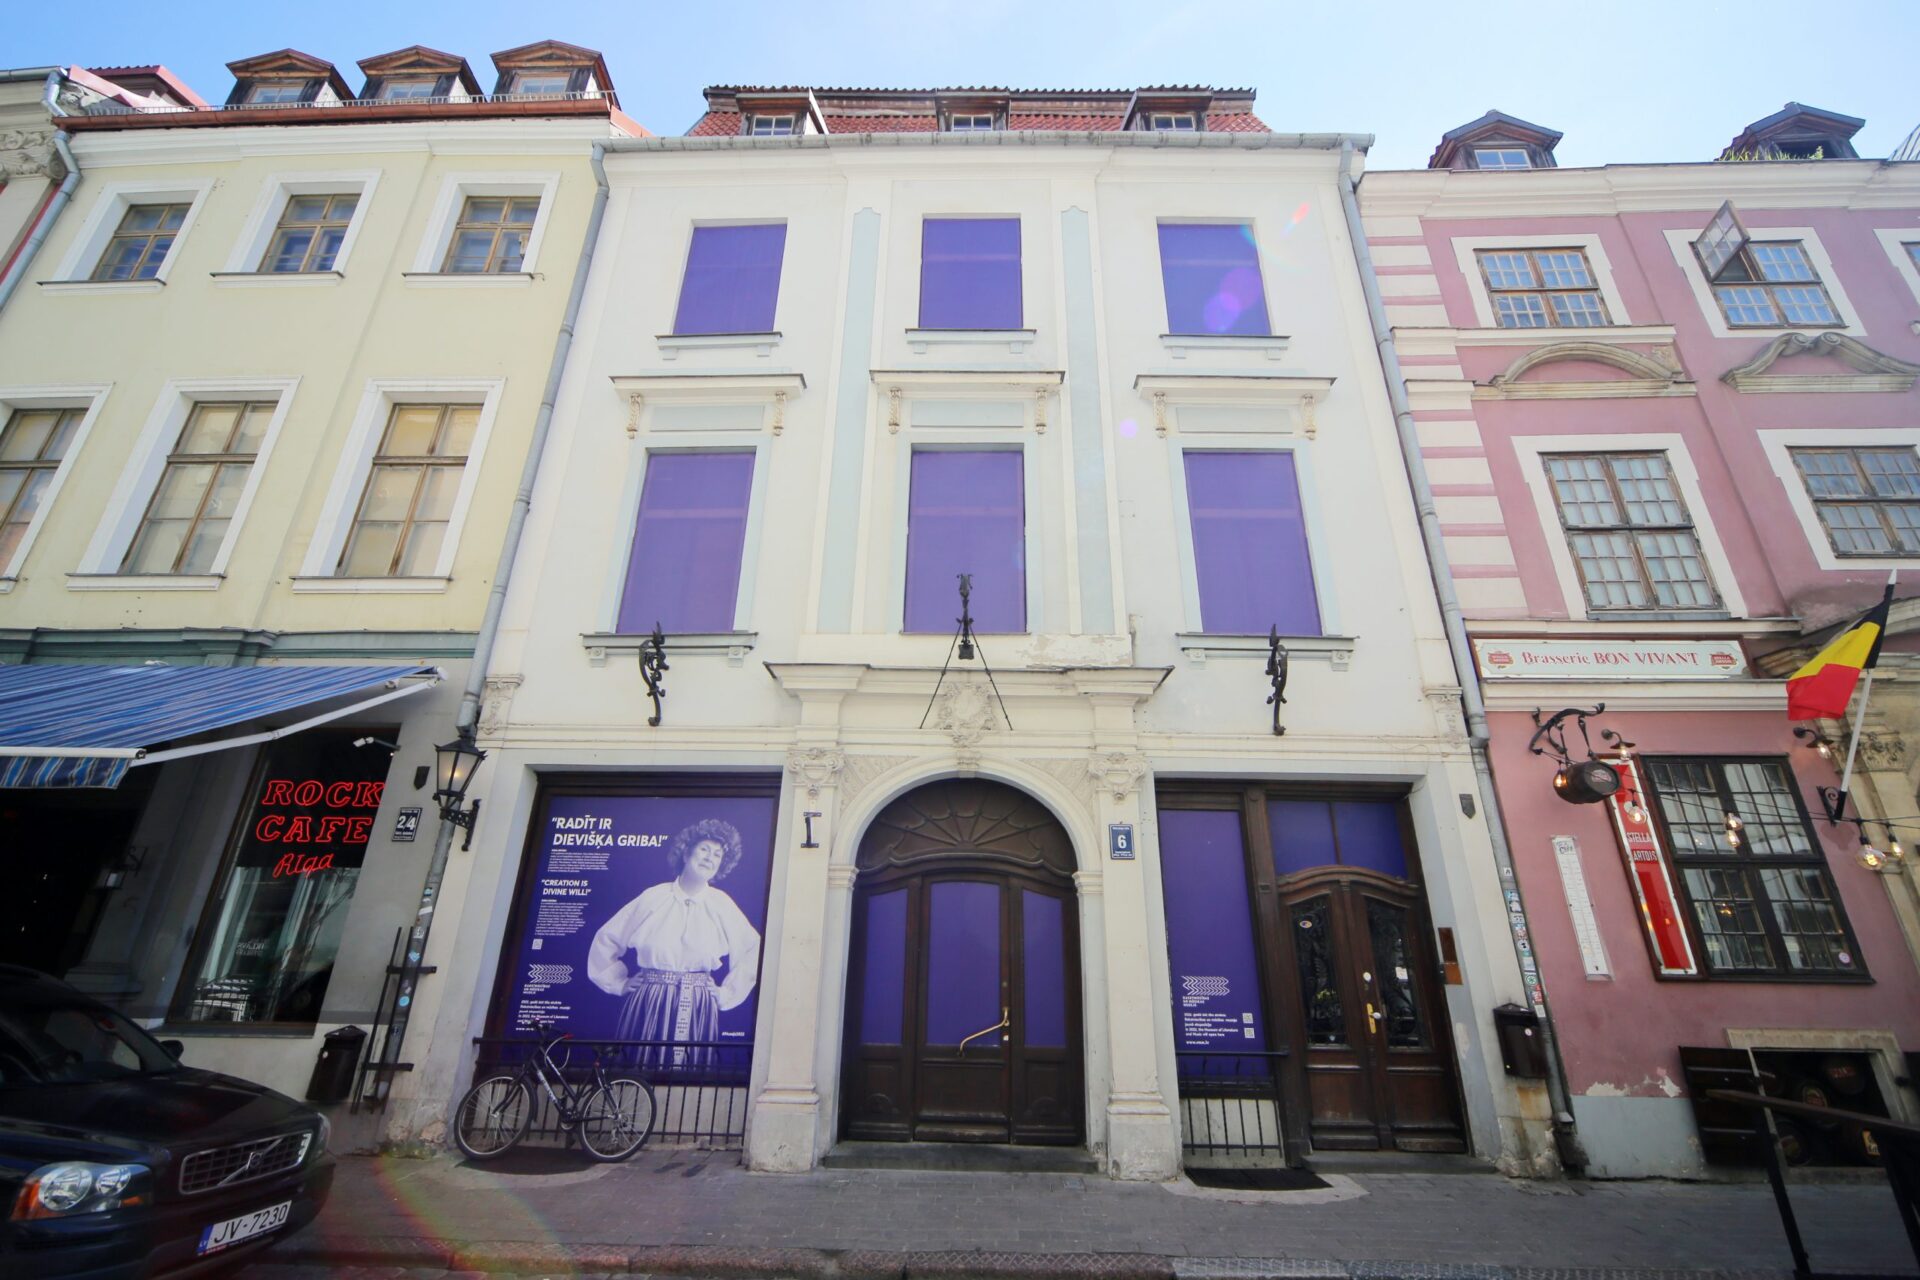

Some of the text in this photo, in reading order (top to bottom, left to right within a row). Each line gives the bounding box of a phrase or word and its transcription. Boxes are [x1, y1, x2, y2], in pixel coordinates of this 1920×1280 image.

[1521, 651, 1590, 664] Brasserie
[1593, 651, 1631, 665] BON
[1634, 652, 1699, 665] VIVANT
[262, 780, 386, 808] ROCK
[255, 814, 373, 843] CAFE
[598, 818, 612, 830] IR
[553, 831, 614, 849] DIEVIŠĶA
[1117, 834, 1127, 849] 6
[1626, 831, 1652, 843] STELLA
[1633, 850, 1658, 861] ARTOIS
[580, 879, 589, 887] IS
[542, 887, 568, 896] DIVINE
[213, 1204, 288, 1243] JV-7230
